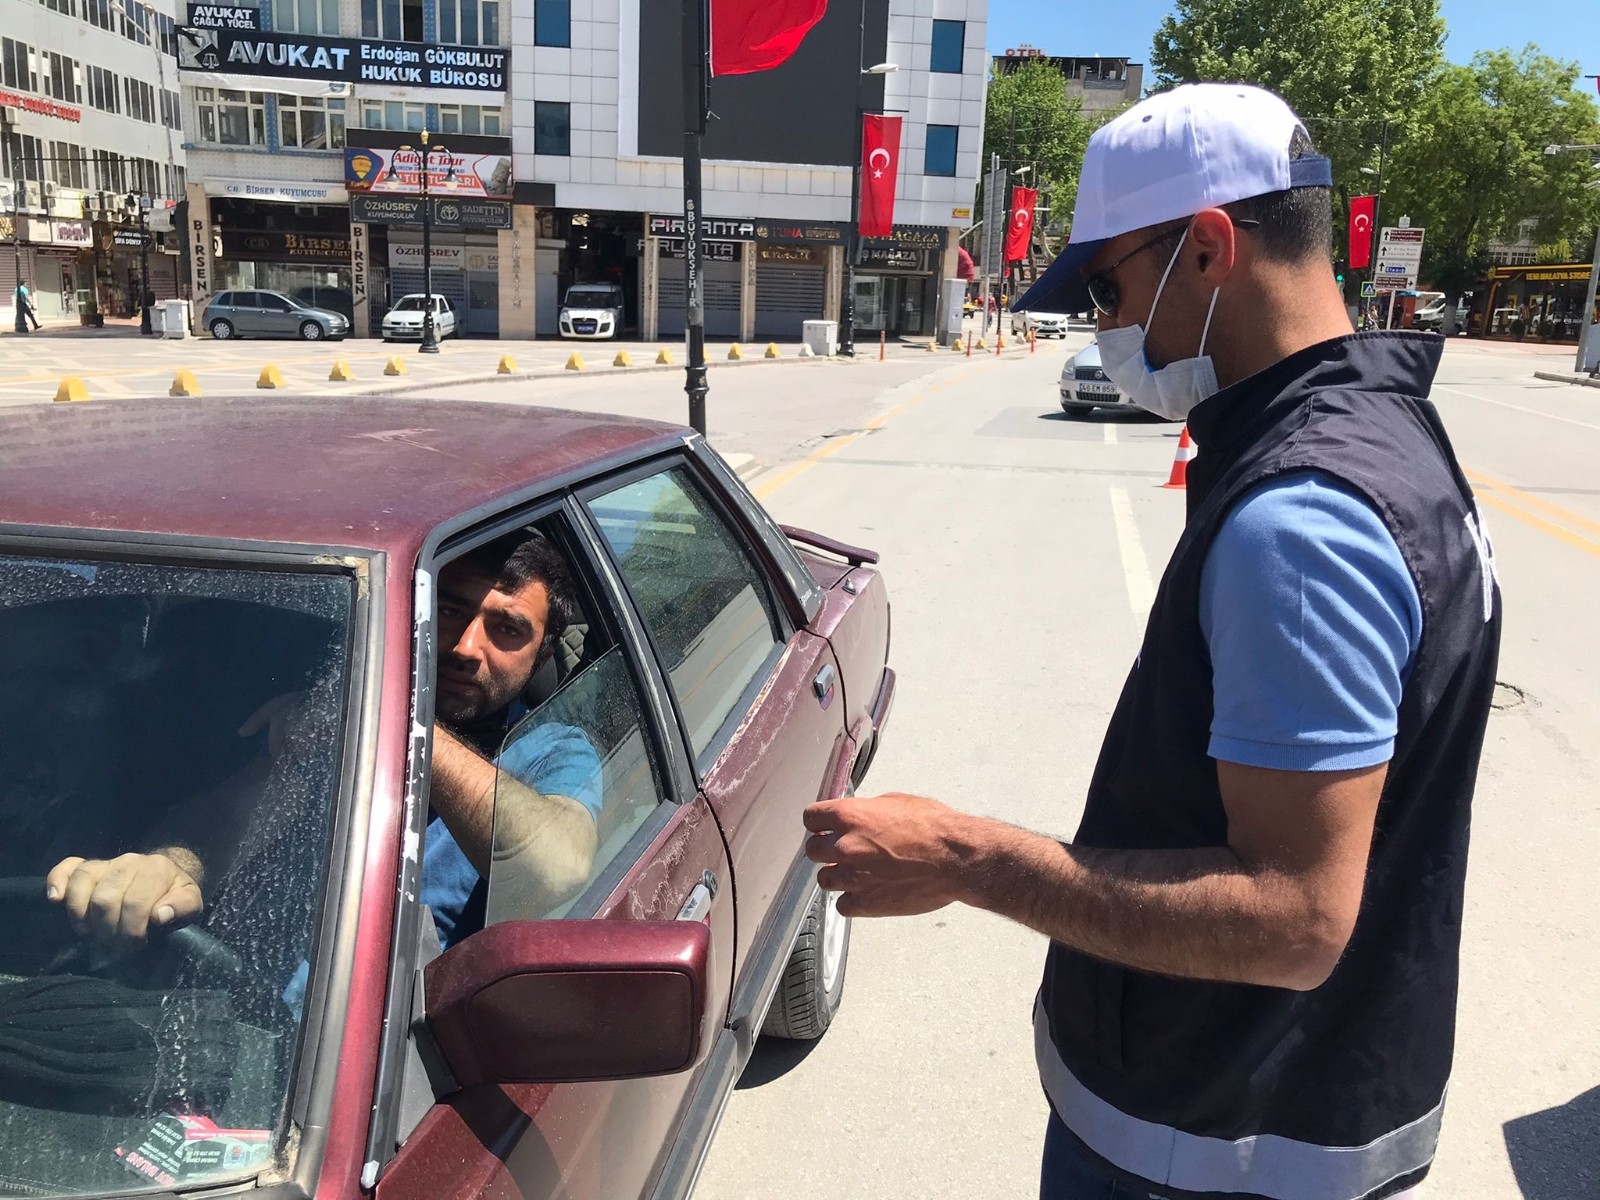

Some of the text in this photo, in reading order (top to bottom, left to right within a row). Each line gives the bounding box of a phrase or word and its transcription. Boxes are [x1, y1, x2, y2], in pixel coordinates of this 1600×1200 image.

[194, 5, 253, 20] AVUKAT
[192, 16, 256, 30] ÇAĞLA YÜCEL
[227, 40, 350, 71] AVUKAT
[360, 44, 505, 69] Erdoğan GÖKBULUT
[1005, 48, 1046, 59] OTEL
[361, 64, 503, 88] HUKUK BÜROSU
[437, 154, 466, 167] Tour
[279, 187, 328, 198] KUYUMCUSU
[363, 200, 419, 212] ÖZHÜSREV
[366, 211, 416, 220] KUYUMCULUK
[650, 218, 755, 237] PIRANTA
[284, 233, 351, 250] BİRSE
